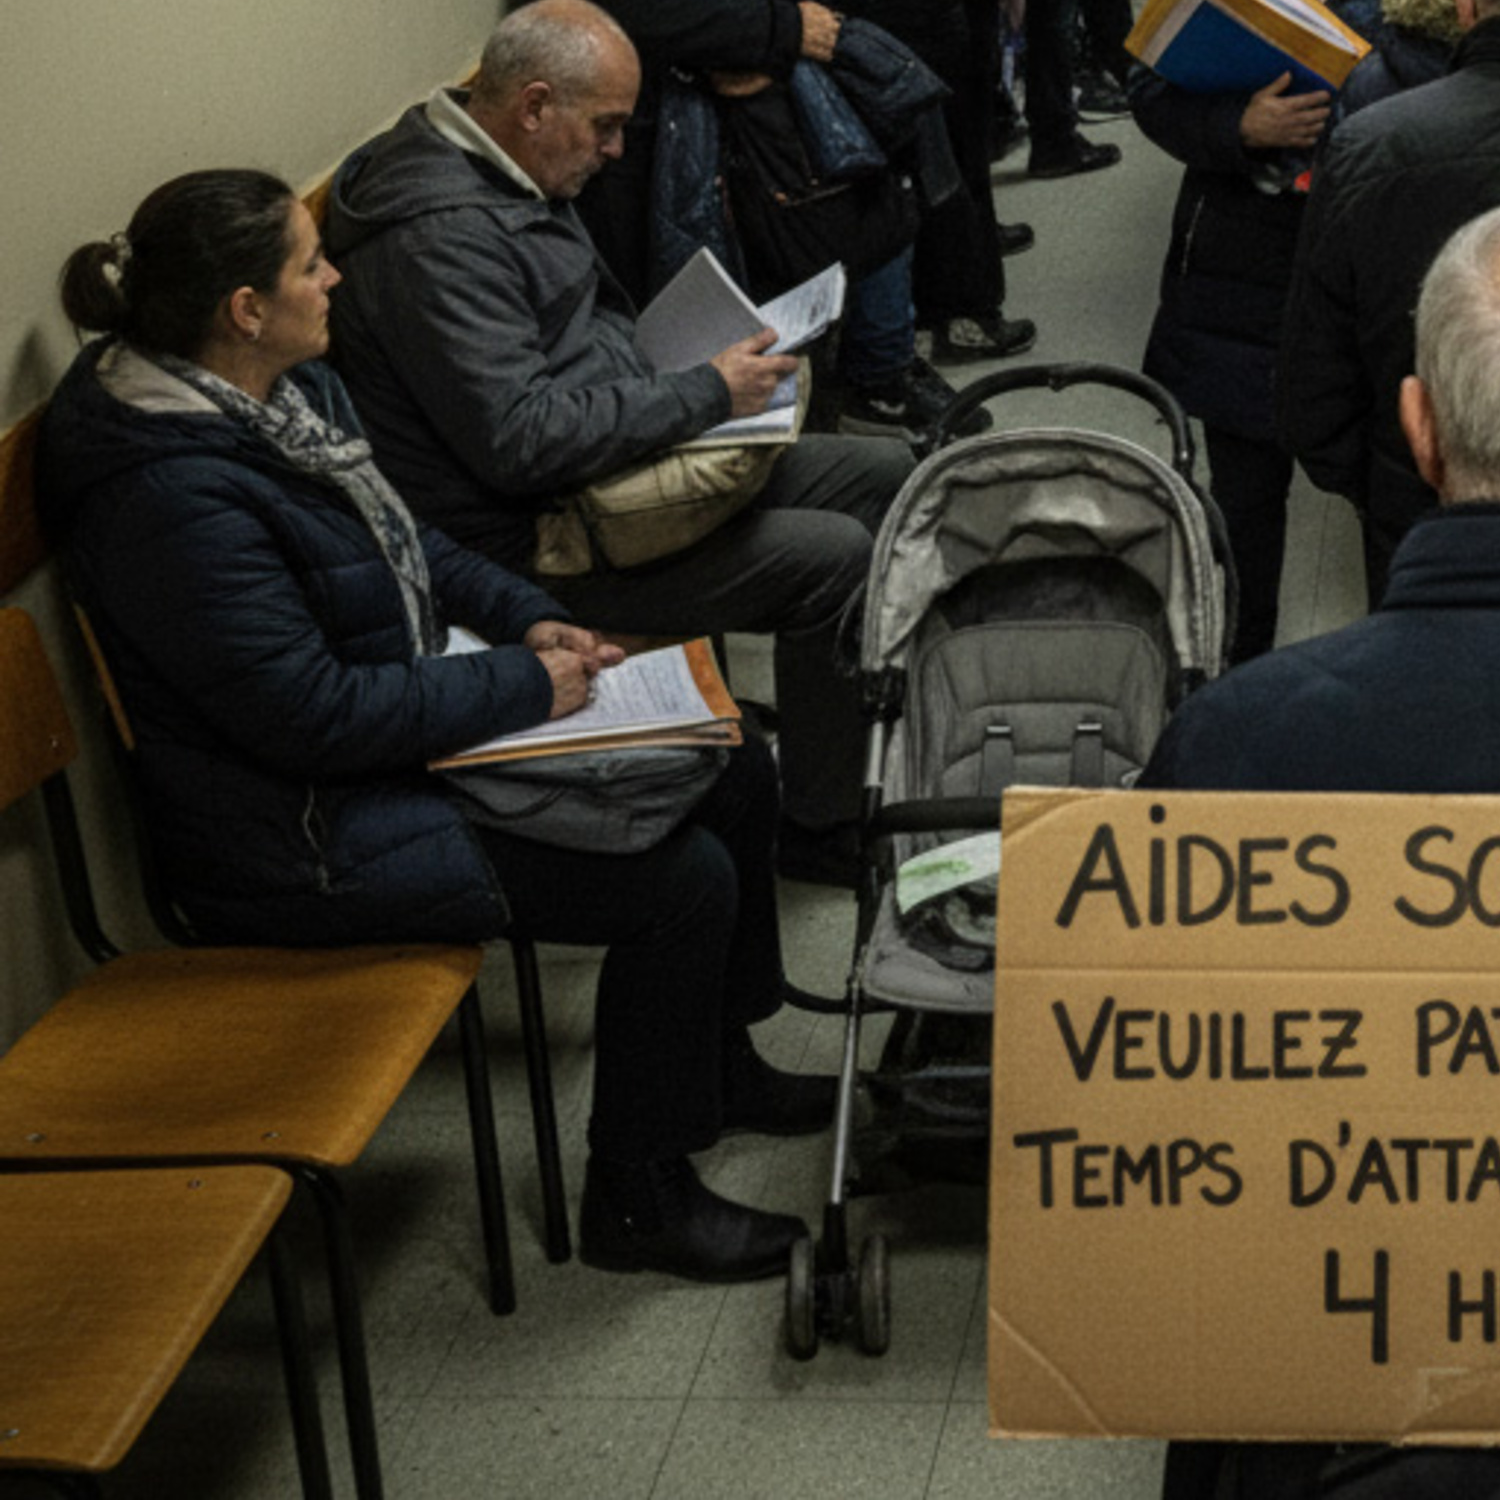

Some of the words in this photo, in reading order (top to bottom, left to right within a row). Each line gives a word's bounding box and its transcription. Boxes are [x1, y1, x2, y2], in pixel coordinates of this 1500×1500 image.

[1050, 995, 1368, 1083] VEUILEZ
[1011, 1127, 1244, 1210] TEMPS
[1323, 1248, 1391, 1366] 4
